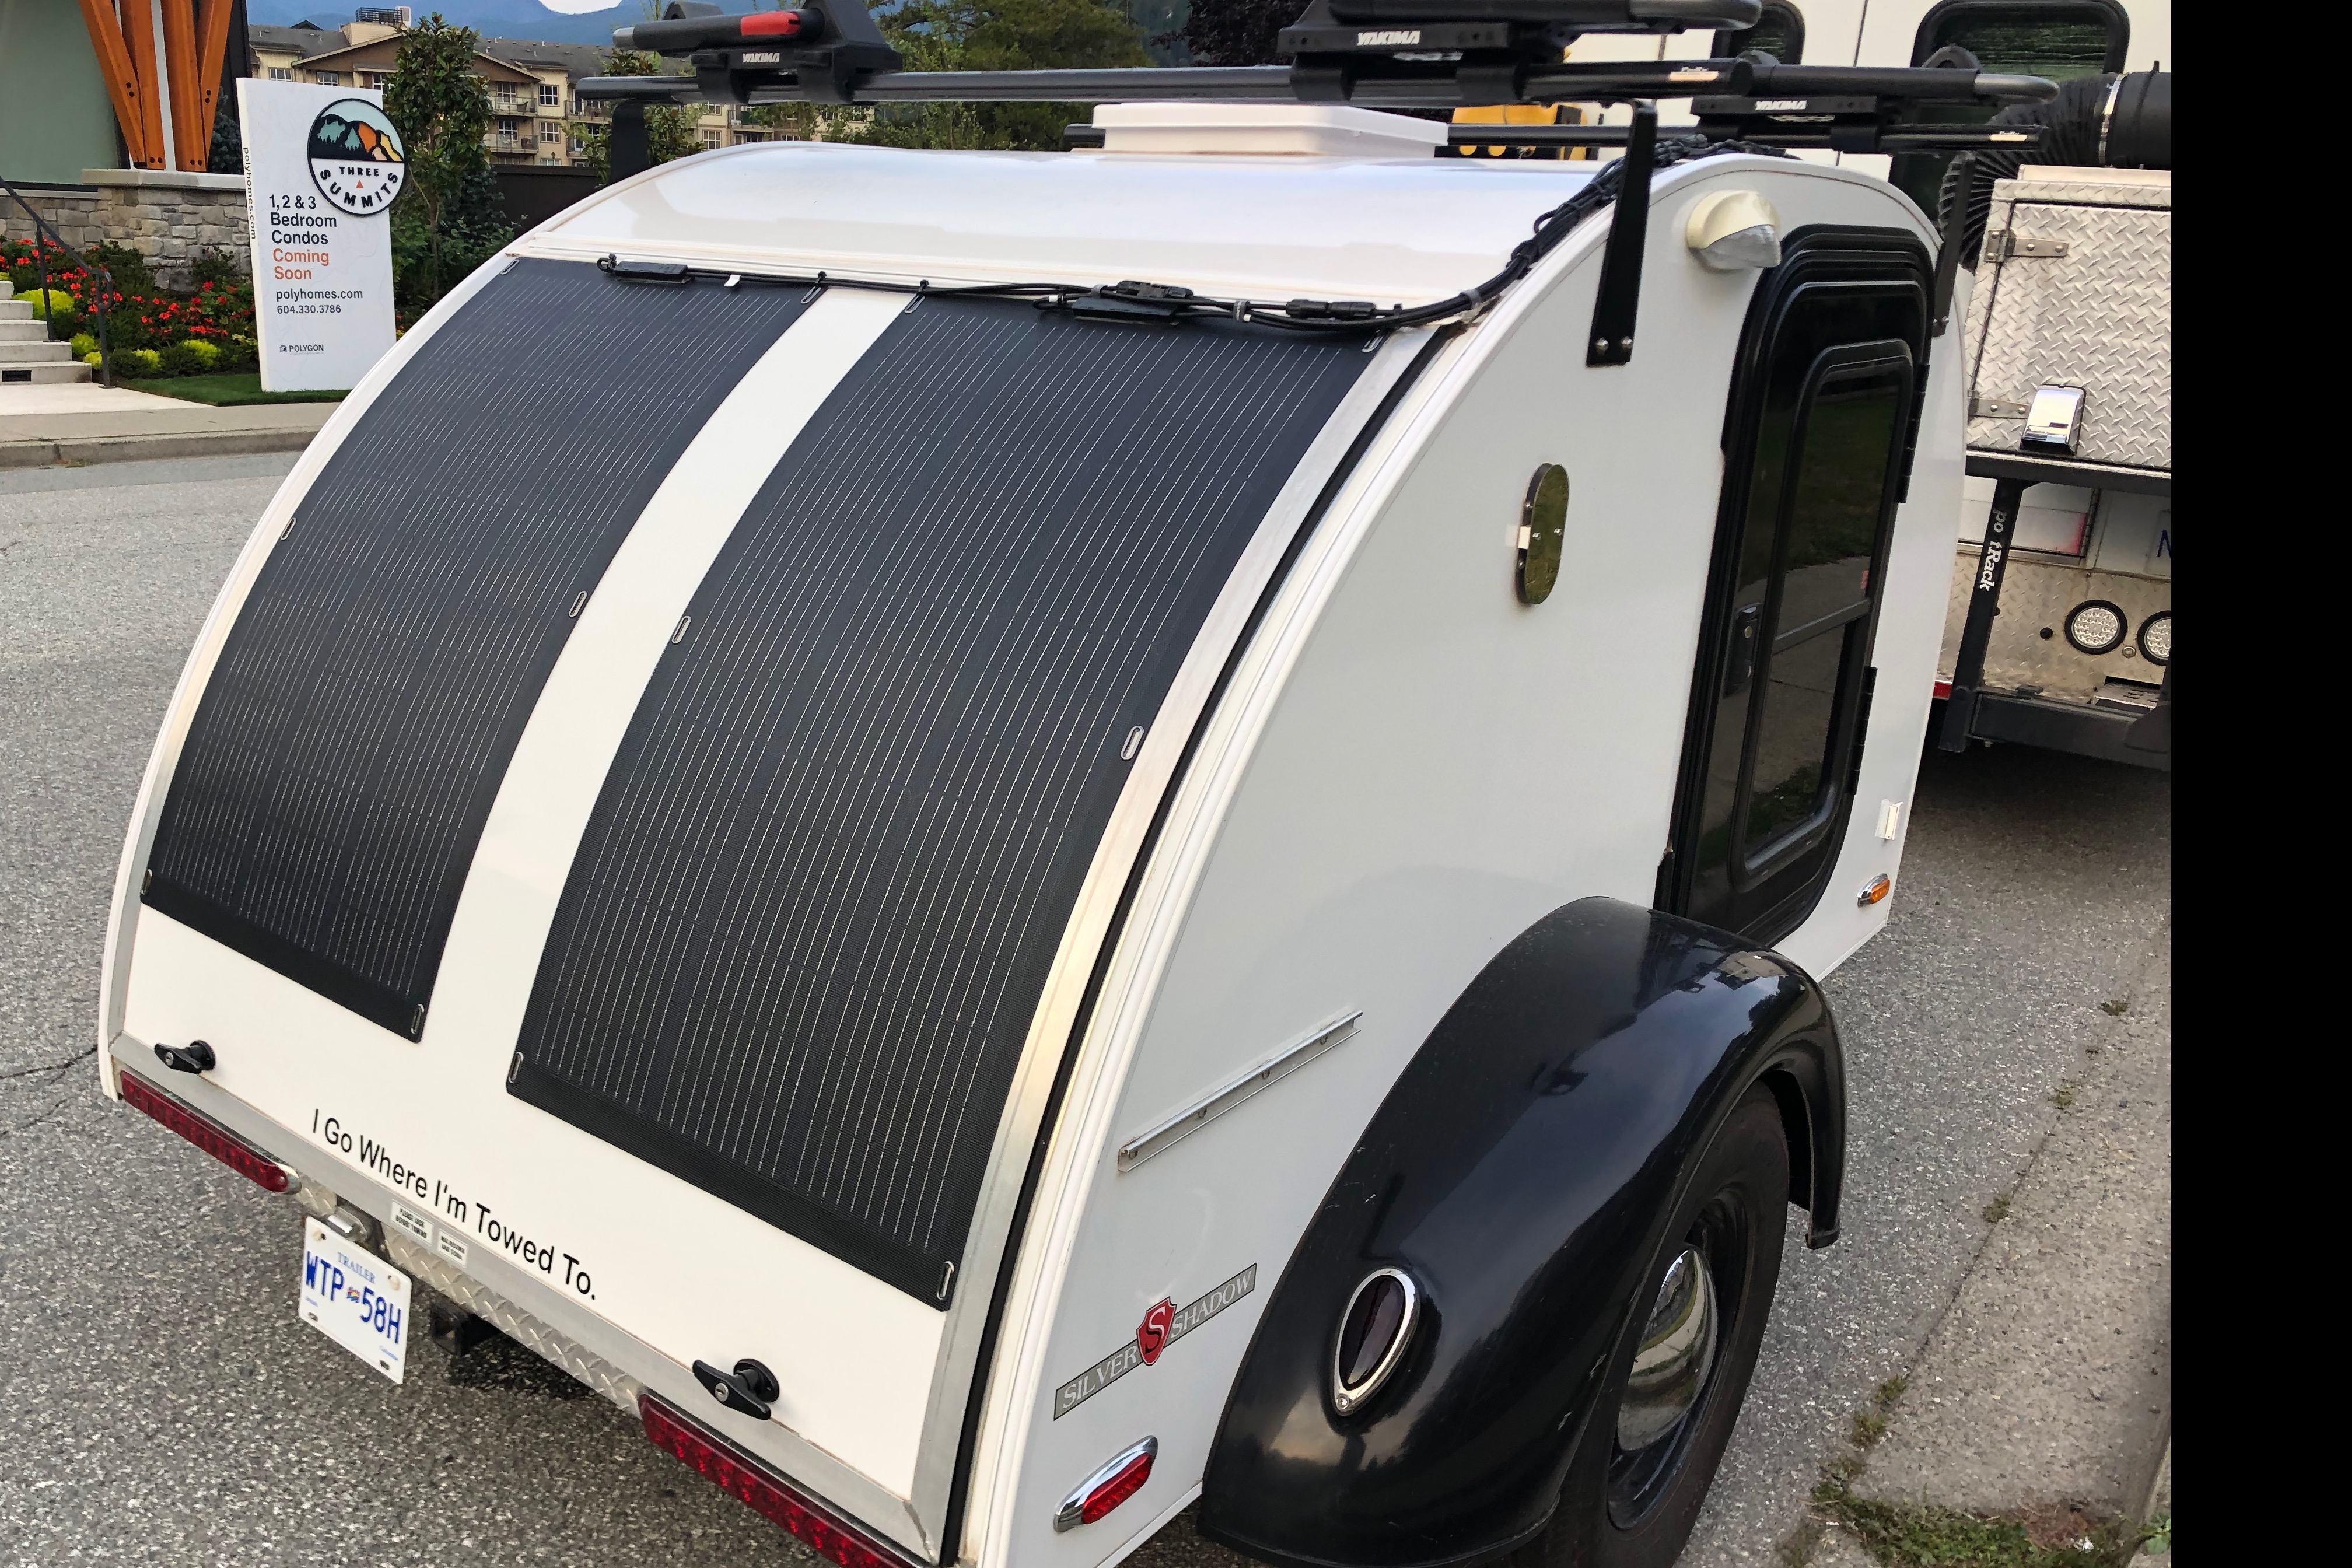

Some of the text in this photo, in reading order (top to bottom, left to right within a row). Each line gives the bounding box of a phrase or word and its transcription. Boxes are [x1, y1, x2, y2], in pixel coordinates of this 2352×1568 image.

[1357, 30, 1421, 46] YAKIMA
[742, 52, 780, 63] YAKIMA
[1755, 100, 1807, 110] YAKIMA
[339, 166, 379, 177] THREE
[243, 147, 256, 239] polyhomes.com
[320, 169, 398, 208] SUMMITS
[295, 195, 305, 209] &
[308, 196, 316, 209] 3
[270, 212, 337, 228] Bedroom
[271, 230, 328, 244] Condos
[273, 248, 330, 267] Coming
[274, 265, 312, 280] Soon
[276, 288, 363, 302] polyhomes.com
[277, 304, 341, 314] 604.330.3786
[289, 344, 324, 352] POLYGON
[313, 1108, 319, 1133] I
[325, 1118, 352, 1153] Go
[360, 1134, 428, 1198] Where
[435, 1180, 467, 1223] I'm
[476, 1202, 555, 1275] Towed
[563, 1253, 595, 1300] To.
[337, 1252, 376, 1284] TRAILER
[306, 1251, 402, 1344] WTP 58H
[1062, 1345, 1138, 1410] SILVER
[1170, 1271, 1252, 1339] SHADOW
